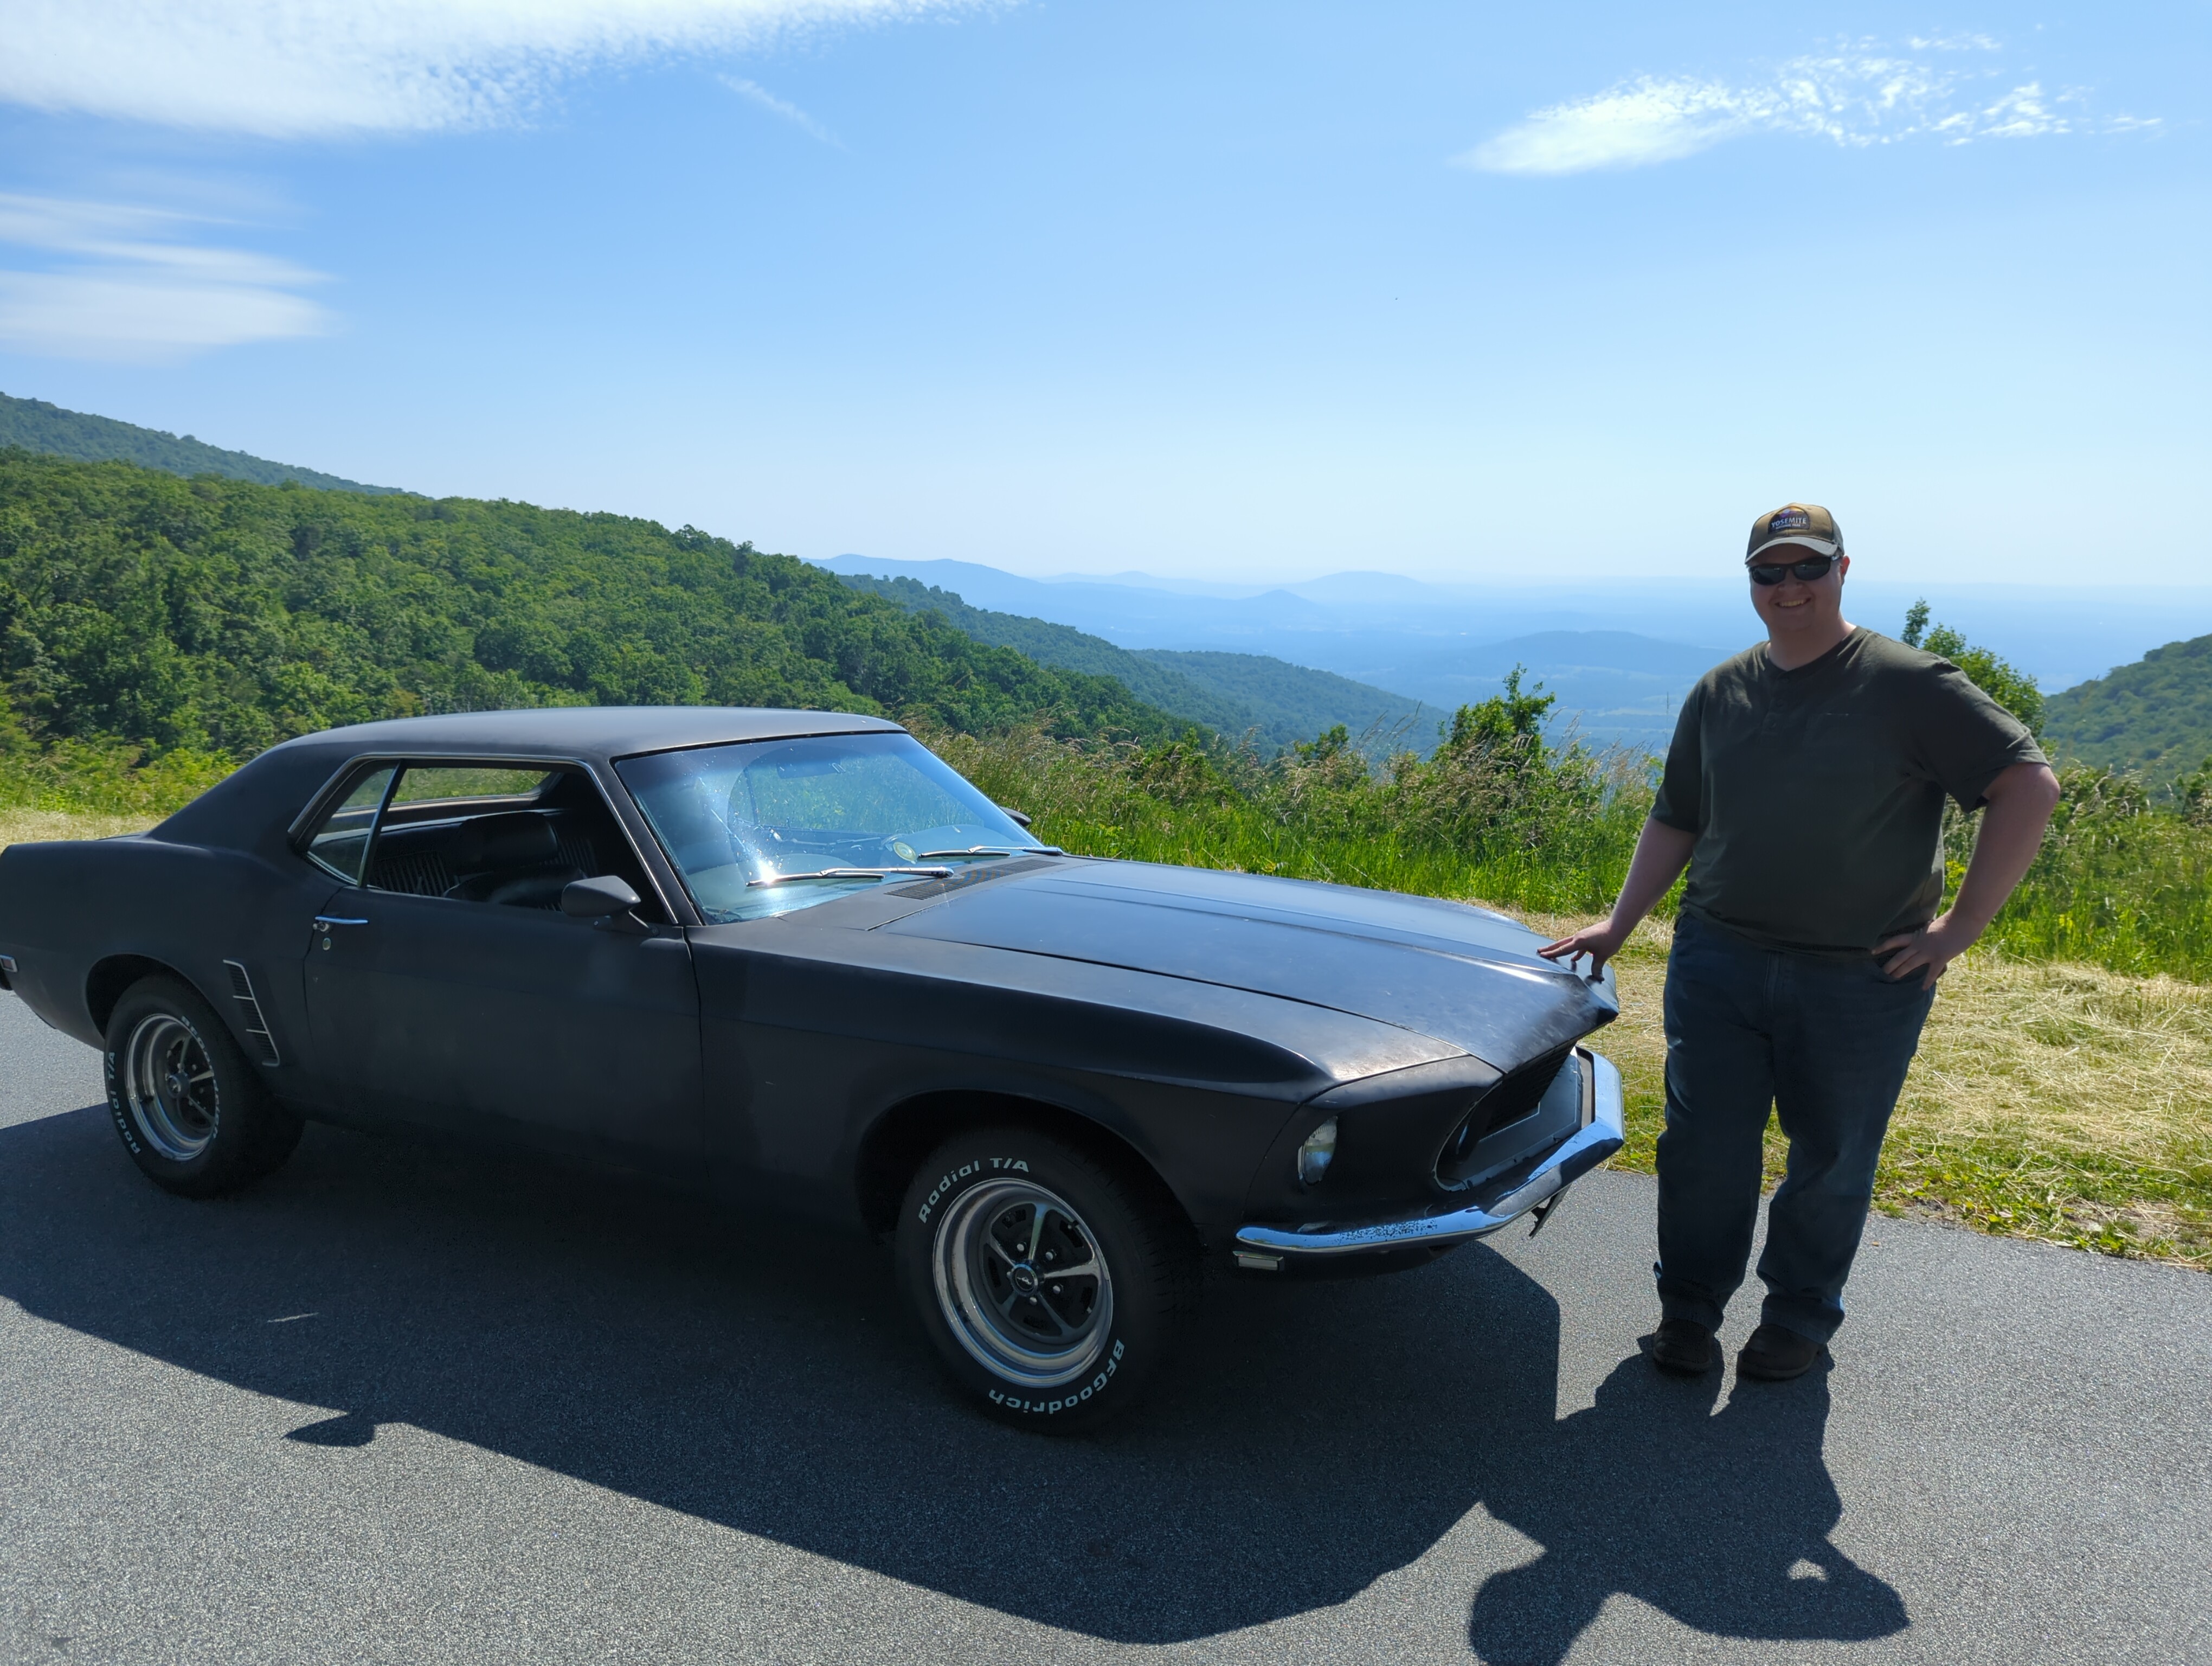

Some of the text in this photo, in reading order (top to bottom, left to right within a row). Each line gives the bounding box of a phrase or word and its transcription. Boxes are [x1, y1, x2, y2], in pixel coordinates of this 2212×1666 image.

[1771, 517, 1806, 528] YOSEMITE
[110, 1090, 142, 1154] Radial
[918, 1157, 1030, 1223] Radial T/A
[988, 1339, 1125, 1414] BFGoodrich
